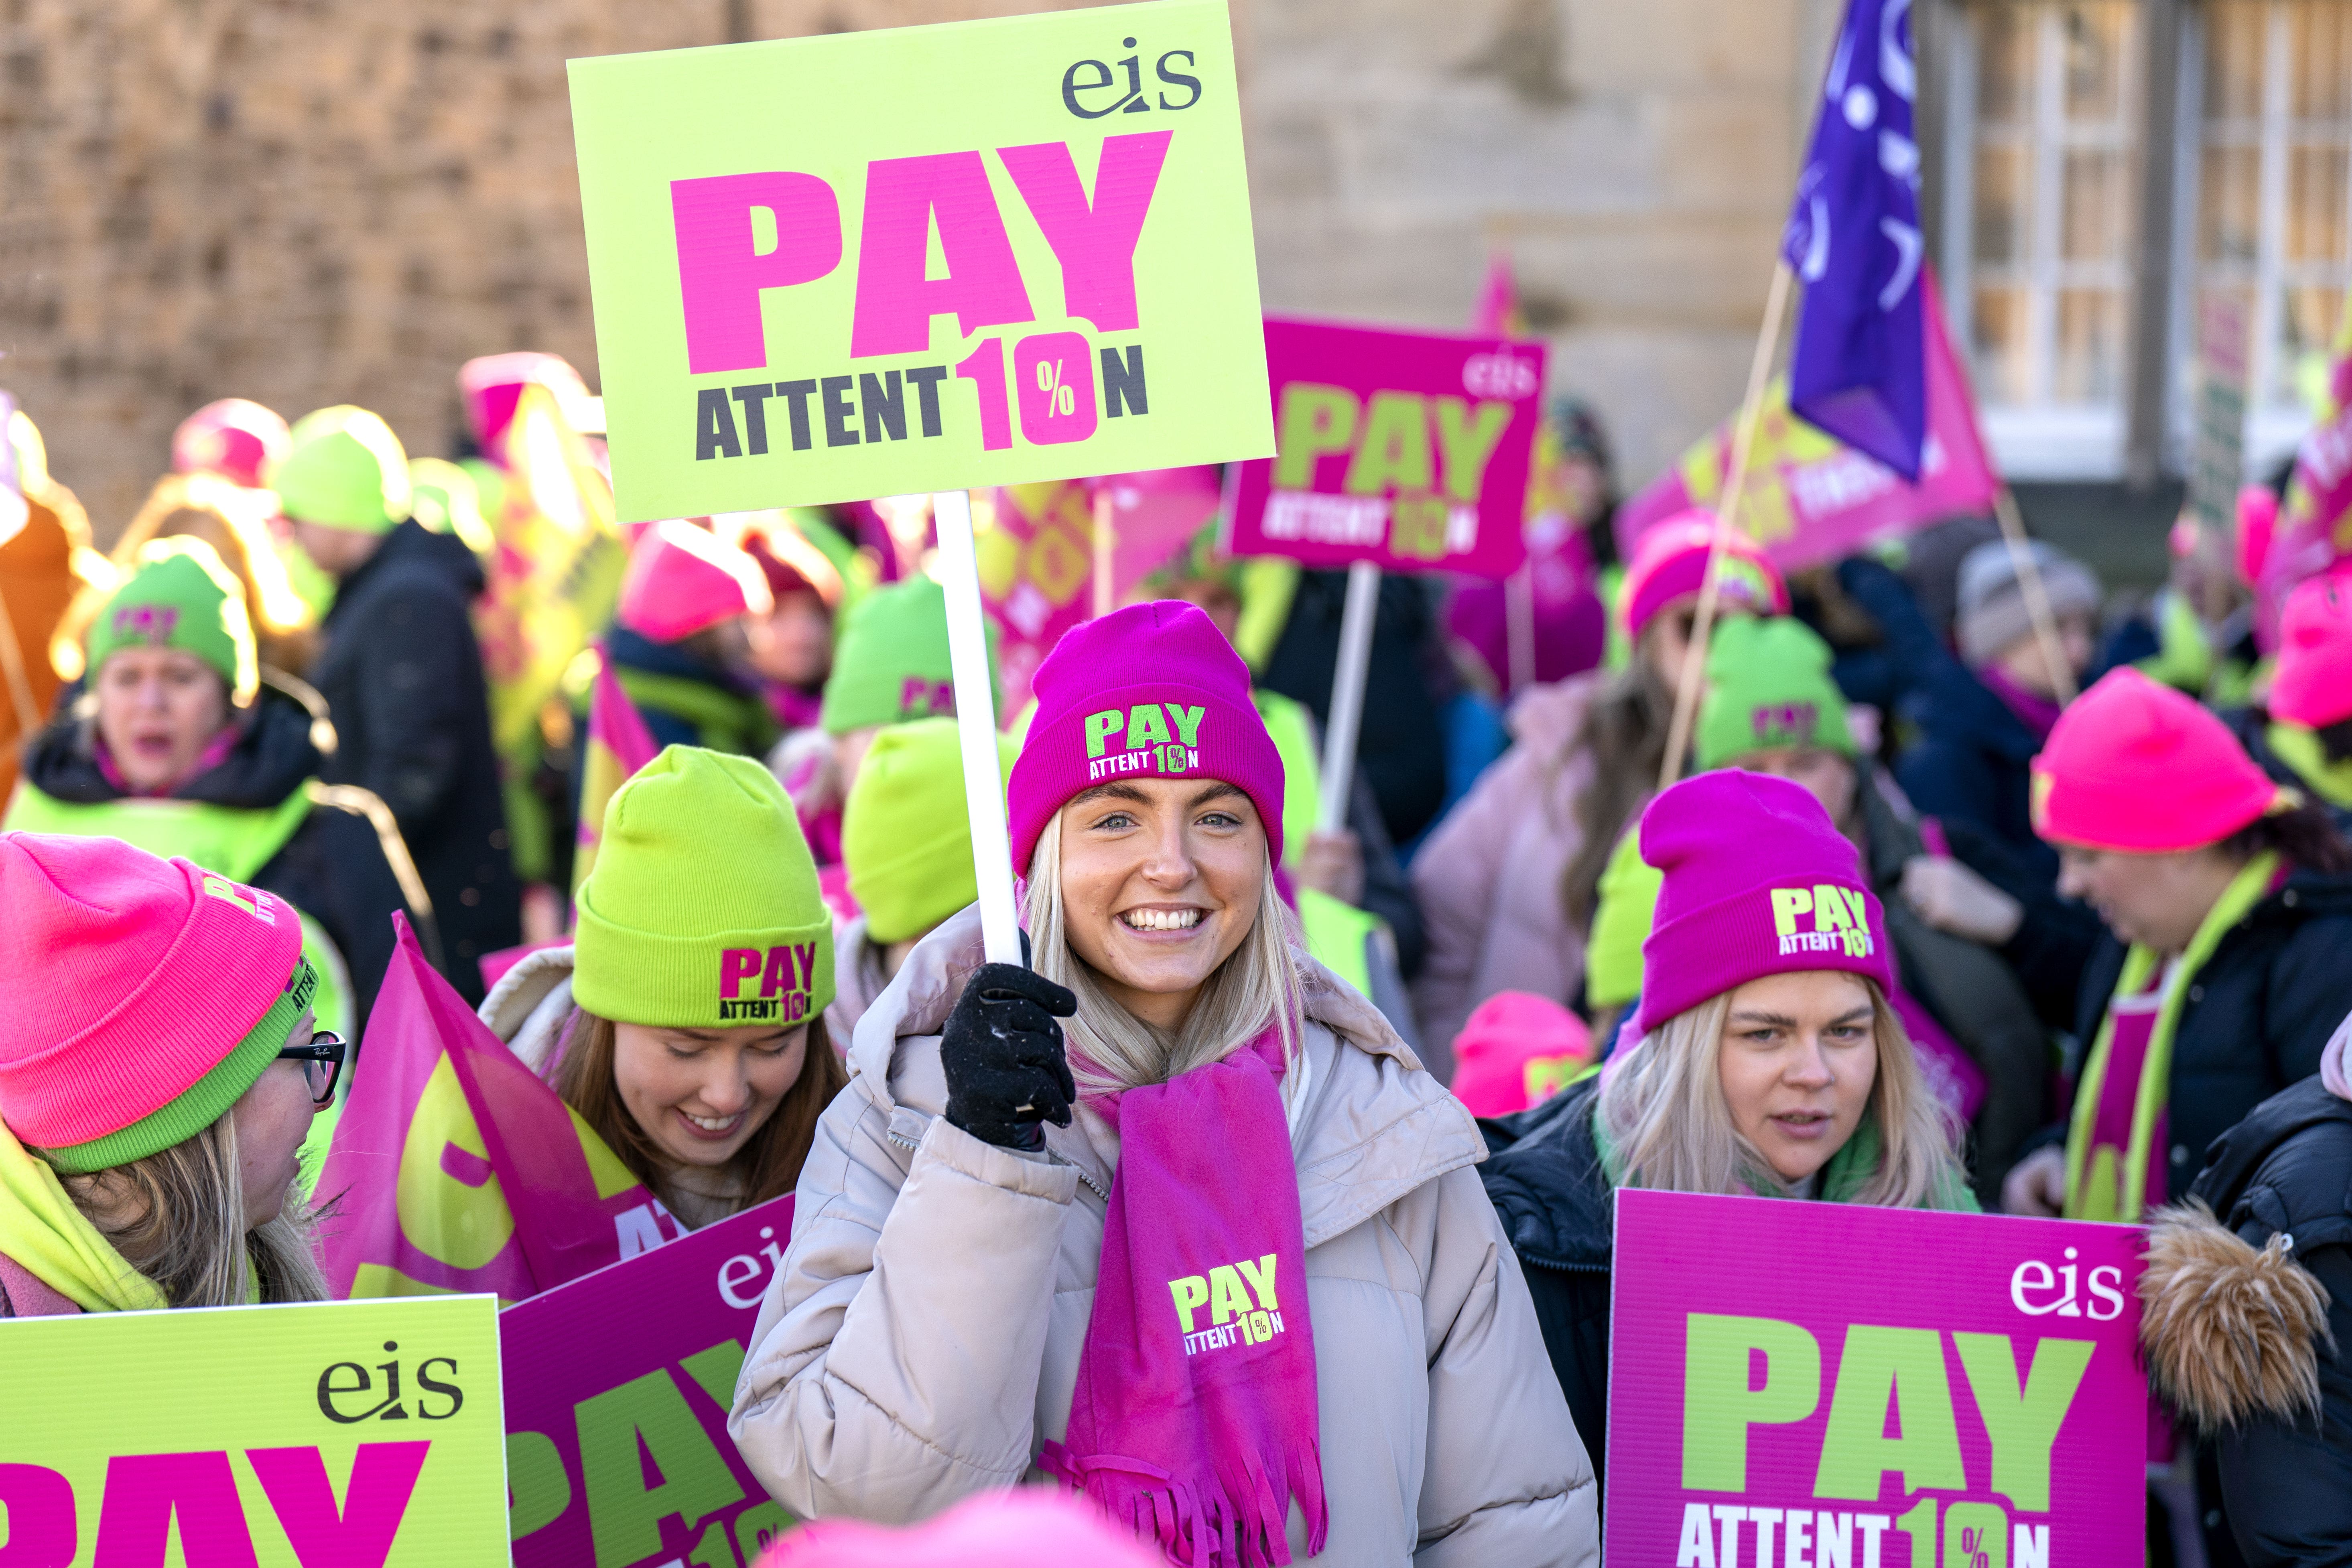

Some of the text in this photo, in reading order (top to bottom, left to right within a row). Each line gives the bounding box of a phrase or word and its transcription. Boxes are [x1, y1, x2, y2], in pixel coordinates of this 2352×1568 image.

[1061, 37, 1202, 119] eis
[669, 129, 1174, 375] PAY
[1271, 380, 1515, 503] PAY
[900, 675, 954, 715] PA
[1085, 703, 1206, 759] PAY
[1770, 884, 1871, 937] PAY
[719, 942, 816, 999] PAY
[717, 1225, 783, 1310] ei
[1168, 1253, 1278, 1334] PAY
[2010, 1246, 2125, 1321] eis
[317, 1341, 464, 1424] eis
[1681, 1312, 2098, 1513] PAY
[506, 1337, 748, 1568] PA
